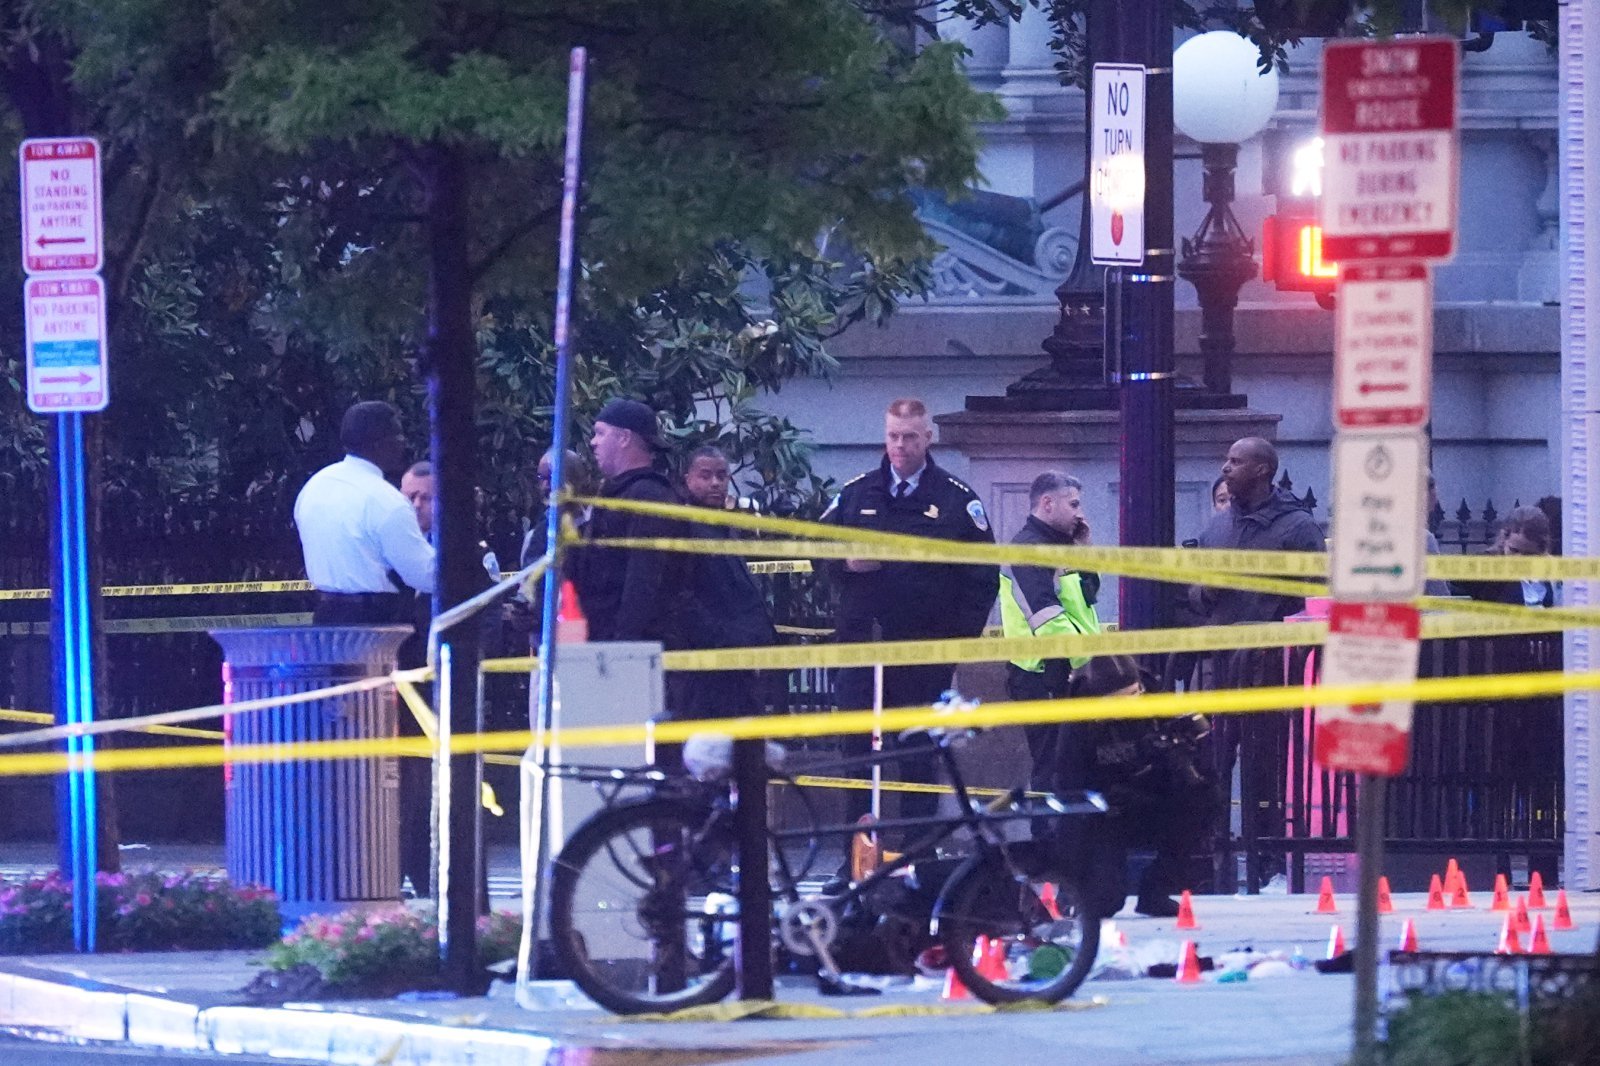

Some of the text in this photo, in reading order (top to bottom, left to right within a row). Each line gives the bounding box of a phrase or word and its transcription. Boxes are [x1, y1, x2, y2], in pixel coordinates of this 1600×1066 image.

[1107, 82, 1129, 117] NO
[1104, 128, 1132, 155] TURN
[51, 169, 70, 180] NO
[34, 185, 88, 198] STANDING
[48, 200, 88, 211] PARKING
[41, 216, 83, 228] ANYTIME
[33, 302, 96, 316] NO PARKING
